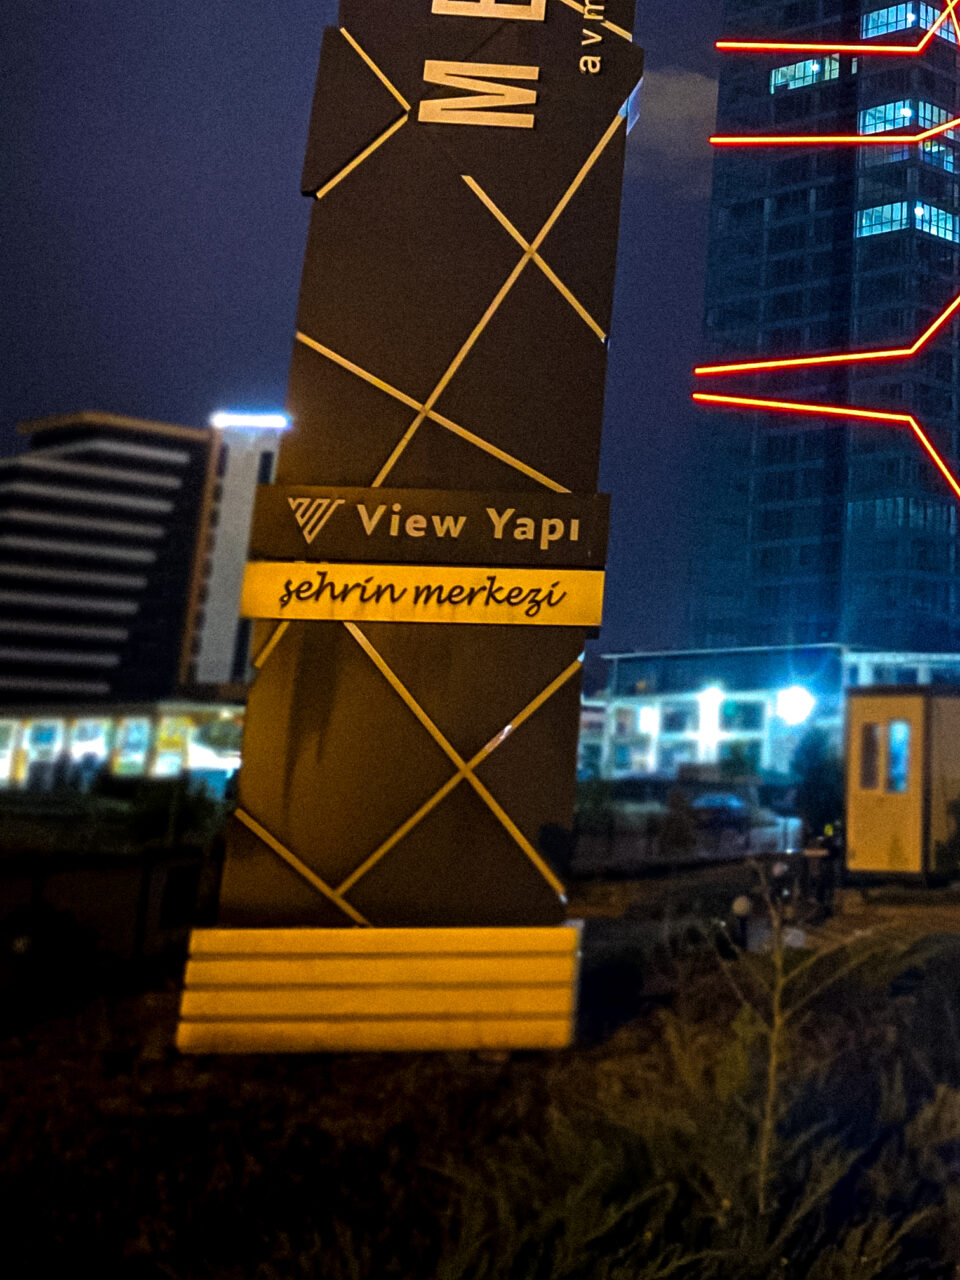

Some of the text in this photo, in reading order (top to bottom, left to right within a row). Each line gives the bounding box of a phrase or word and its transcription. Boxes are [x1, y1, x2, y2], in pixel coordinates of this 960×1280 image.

[357, 503, 580, 550] View Yapı
[412, 575, 567, 617] merkezi
